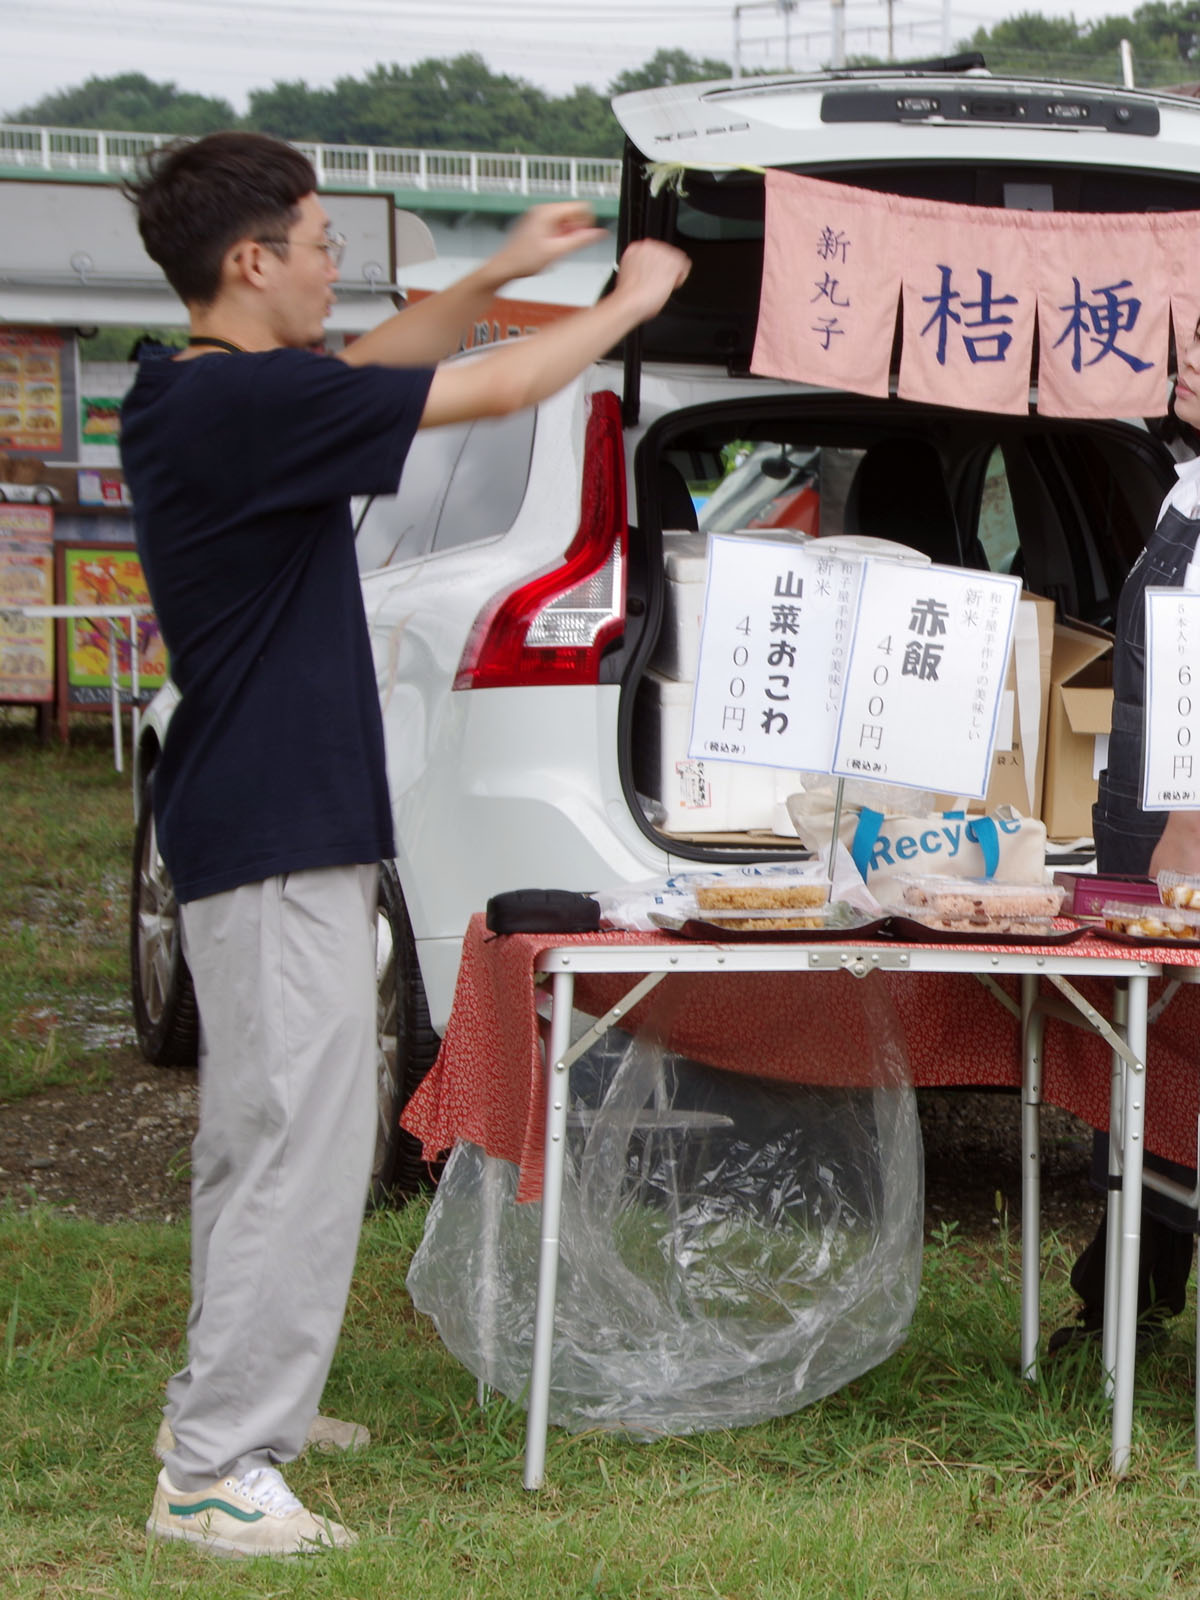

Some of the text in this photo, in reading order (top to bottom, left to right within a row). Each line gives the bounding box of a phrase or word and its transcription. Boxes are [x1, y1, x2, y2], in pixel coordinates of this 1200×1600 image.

[810, 226, 851, 351] 新丸子
[815, 557, 834, 596] 新米
[963, 588, 984, 627] 新米
[722, 615, 751, 731] 400円
[760, 571, 804, 735] 山菜おこわ
[859, 634, 893, 750] 400円
[901, 598, 949, 681] 赤飯
[1172, 665, 1194, 780] 600円
[868, 816, 1022, 871] Recyce
